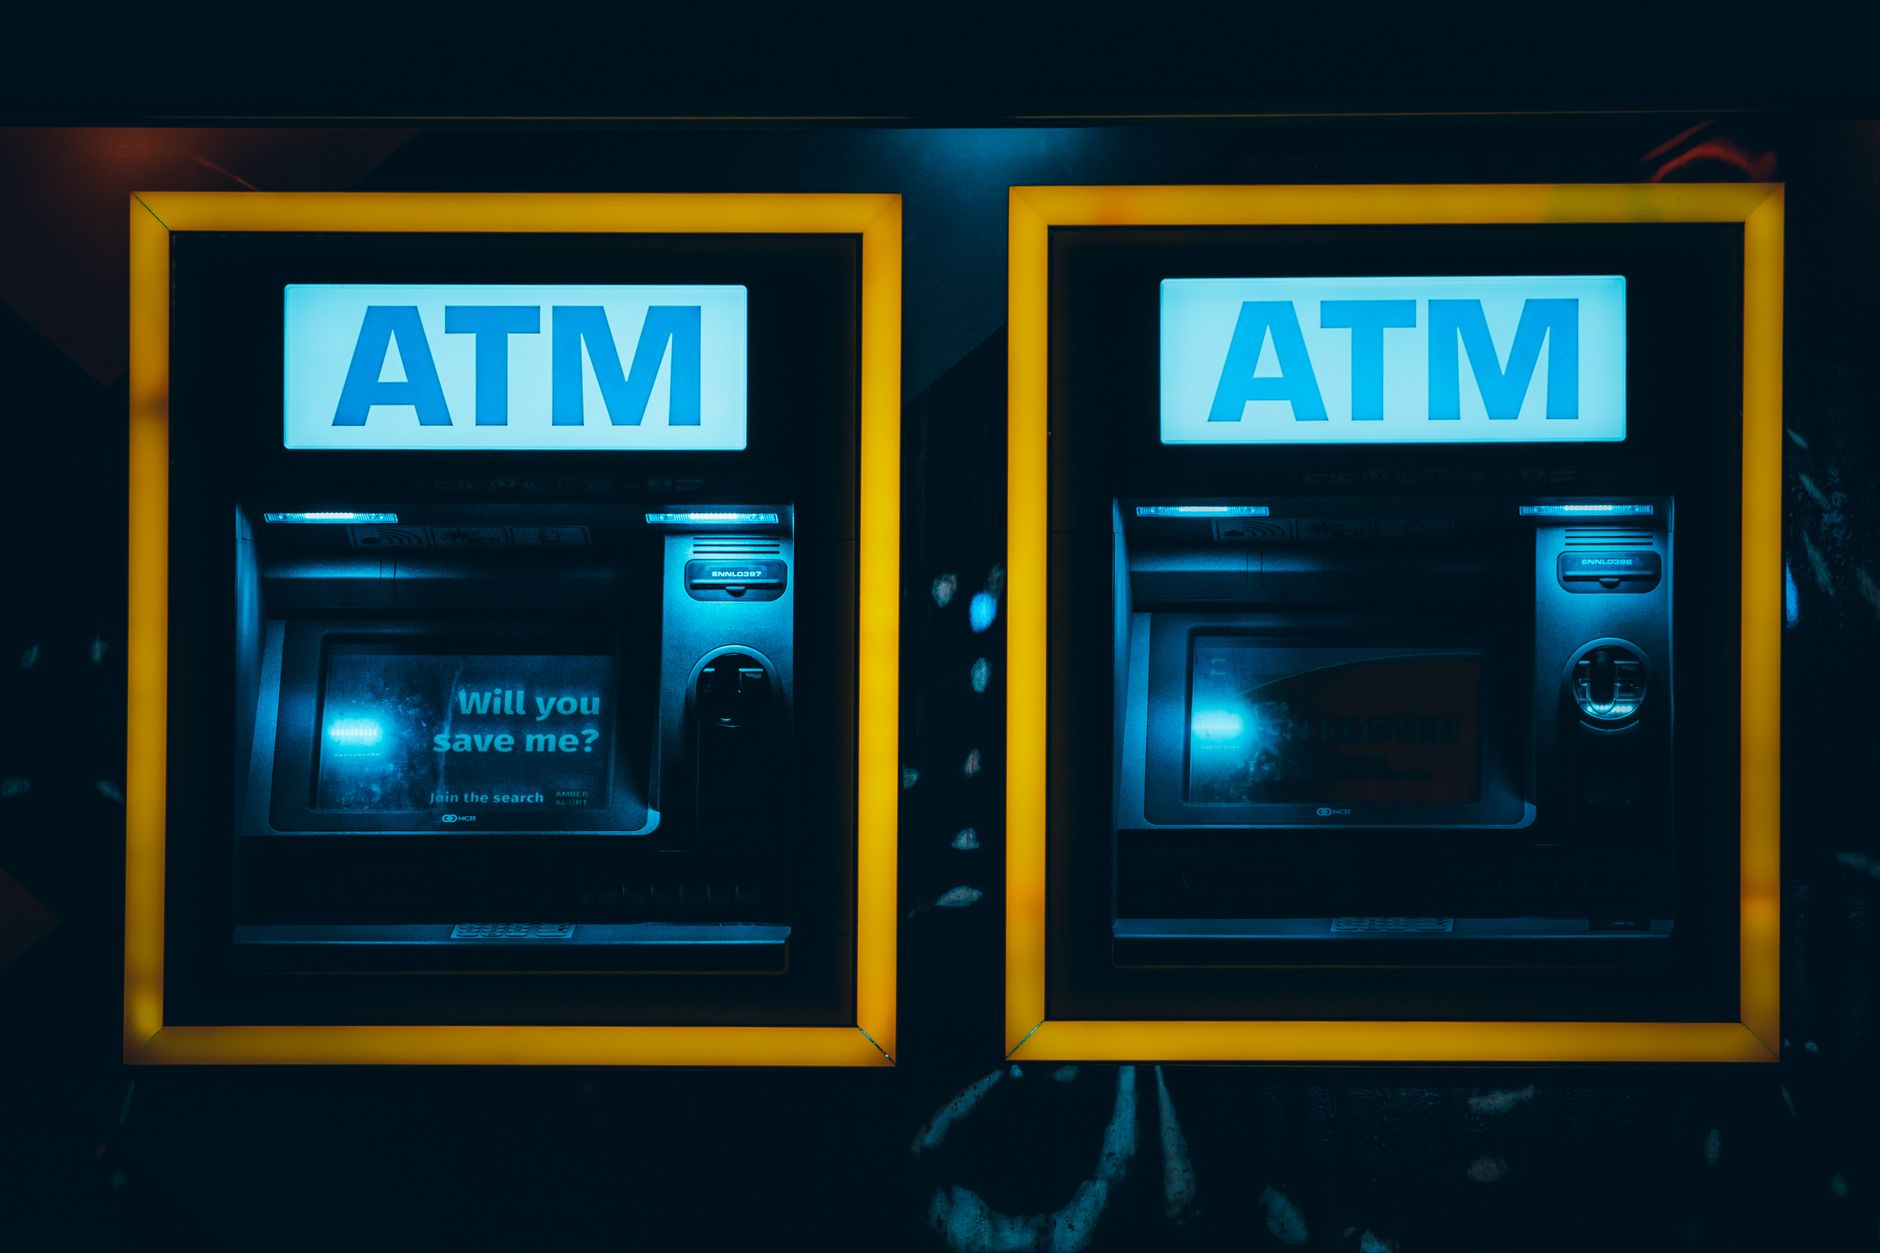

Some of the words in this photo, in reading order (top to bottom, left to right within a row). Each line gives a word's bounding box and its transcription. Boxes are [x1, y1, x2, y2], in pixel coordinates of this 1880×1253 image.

[332, 305, 701, 427] ATM
[1208, 298, 1580, 422] ATM
[457, 688, 526, 716] Will
[535, 695, 600, 722] you
[432, 731, 515, 753] save
[525, 728, 599, 753] me?
[429, 791, 459, 805] Join
[463, 791, 488, 804] the
[493, 791, 544, 804] search
